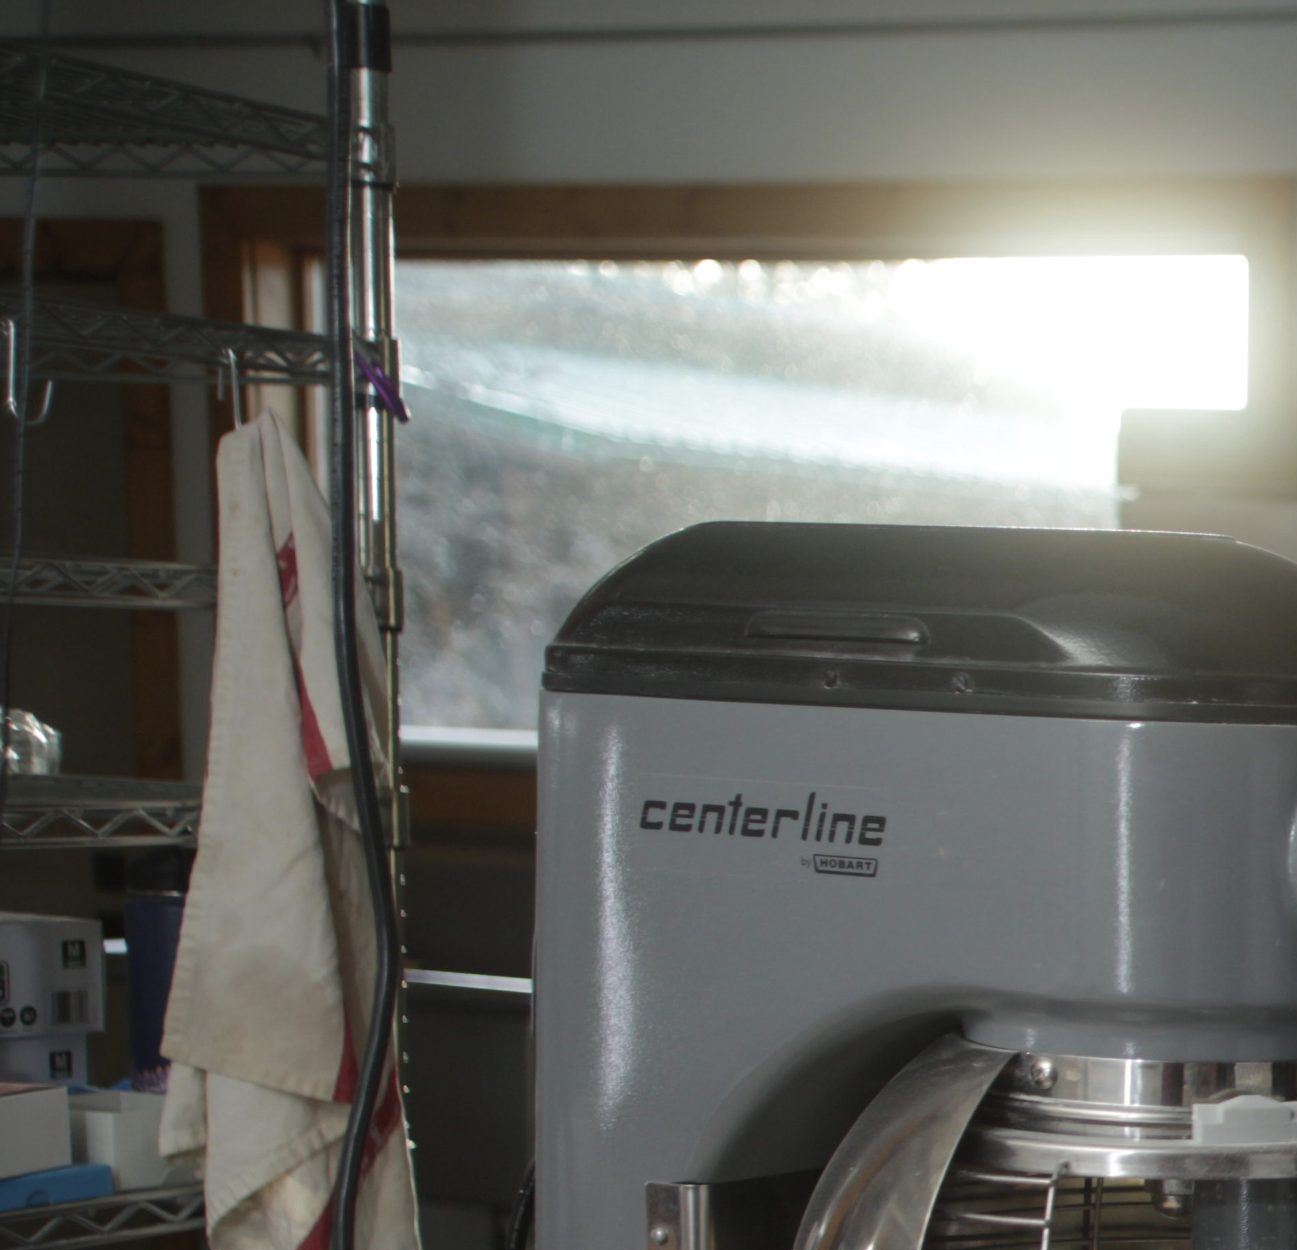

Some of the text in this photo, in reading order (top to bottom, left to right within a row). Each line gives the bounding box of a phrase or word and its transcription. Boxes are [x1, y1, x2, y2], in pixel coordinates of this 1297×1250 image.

[639, 791, 887, 847] centerline
[800, 856, 874, 873] by HOBART
